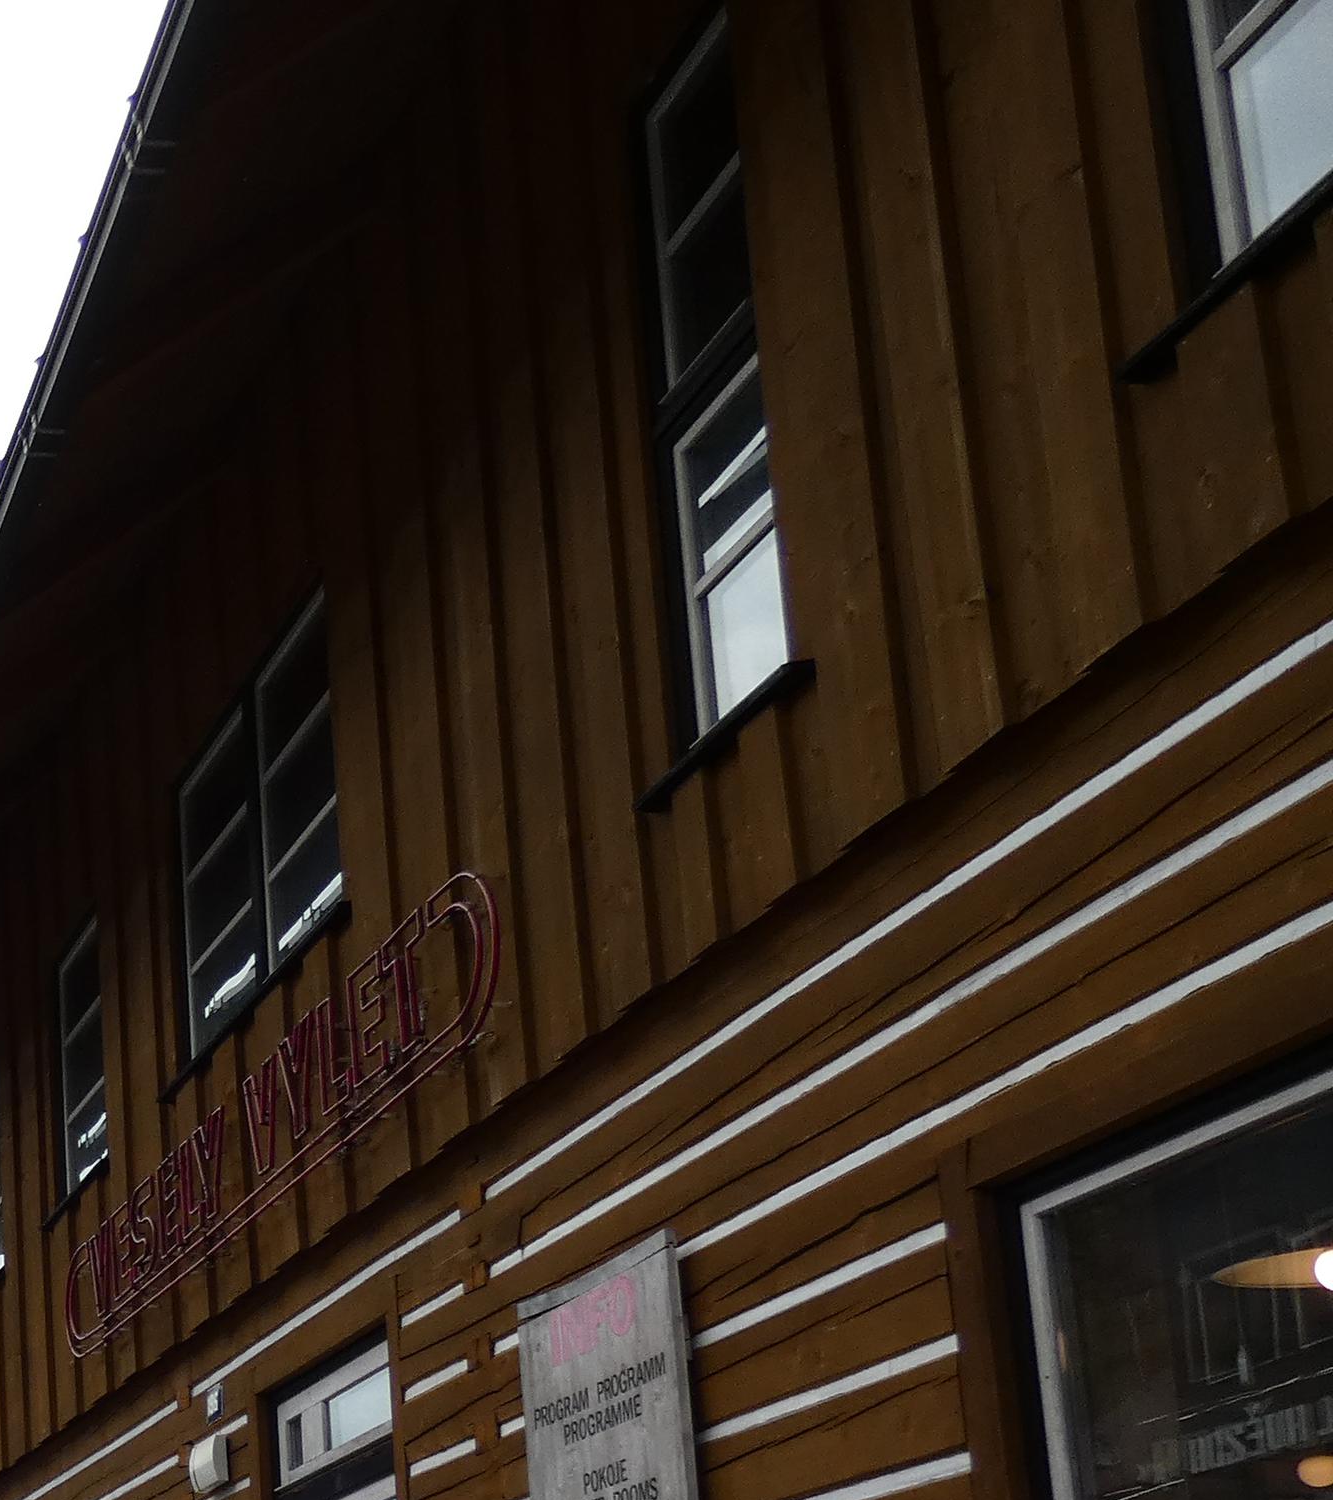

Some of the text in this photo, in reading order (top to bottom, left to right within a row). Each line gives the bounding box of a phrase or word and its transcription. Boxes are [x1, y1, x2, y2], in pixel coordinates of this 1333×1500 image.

[550, 1273, 636, 1367] INFO
[534, 1352, 666, 1430] PROGRAM PROGRAMM
[564, 1394, 642, 1445] PROGRAMME
[584, 1459, 628, 1494] POKOJE
